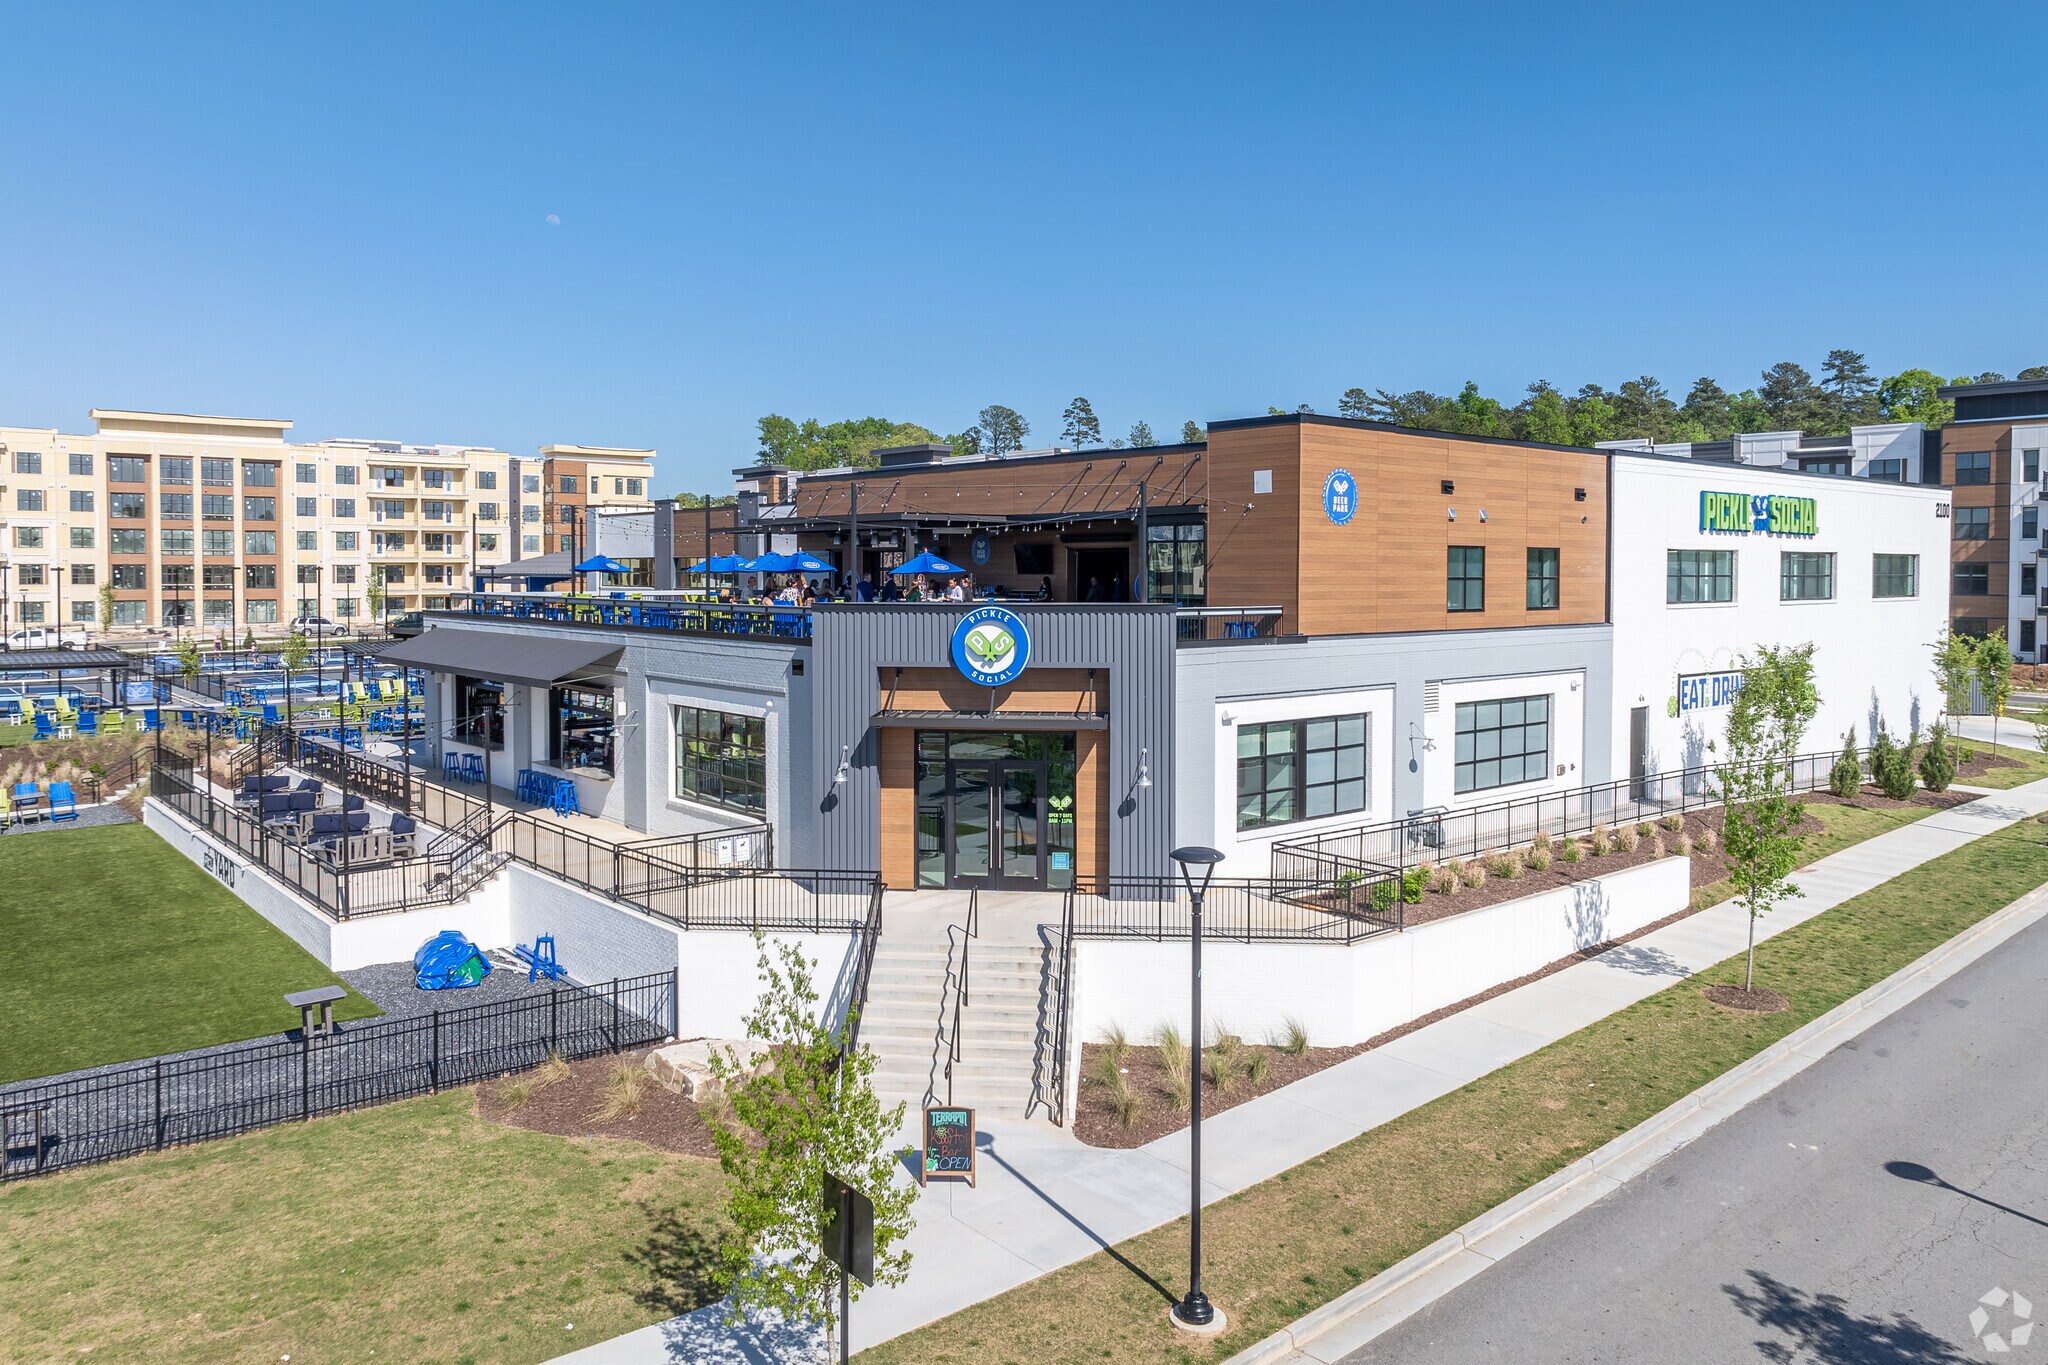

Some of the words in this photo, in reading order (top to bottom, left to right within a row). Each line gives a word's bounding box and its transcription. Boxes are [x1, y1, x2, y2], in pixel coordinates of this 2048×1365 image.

[1333, 496, 1348, 505] BEER
[1332, 504, 1349, 513] PARK
[1700, 491, 1753, 532] PICKLE
[1768, 495, 1820, 535] SOCIAL
[1935, 502, 1950, 518] 2100
[968, 609, 1011, 624] PICKLE
[971, 670, 1012, 683] SOCIAL
[1681, 677, 1707, 710] EAT
[214, 849, 235, 888] YARD
[931, 1111, 968, 1126] TERRAPIN
[941, 1145, 961, 1157] Bar
[939, 1156, 971, 1170] OPEN
